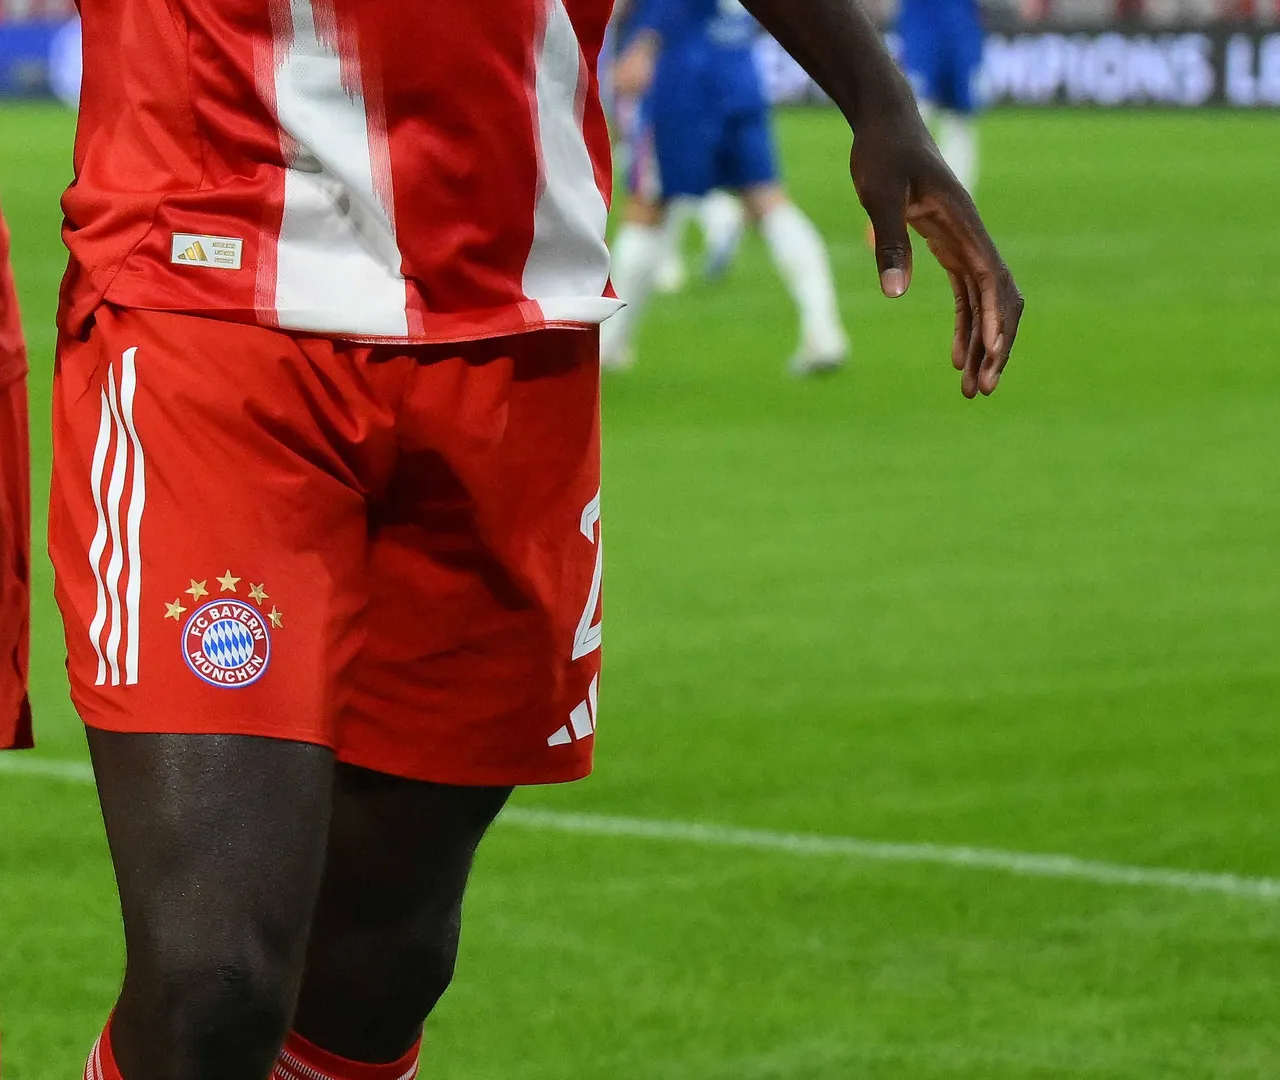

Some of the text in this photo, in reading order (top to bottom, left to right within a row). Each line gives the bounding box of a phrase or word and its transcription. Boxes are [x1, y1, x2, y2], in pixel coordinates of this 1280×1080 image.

[980, 32, 1215, 106] MPIONS
[191, 606, 265, 641] FC BAYERN
[191, 651, 264, 682] MÜNCHEN
